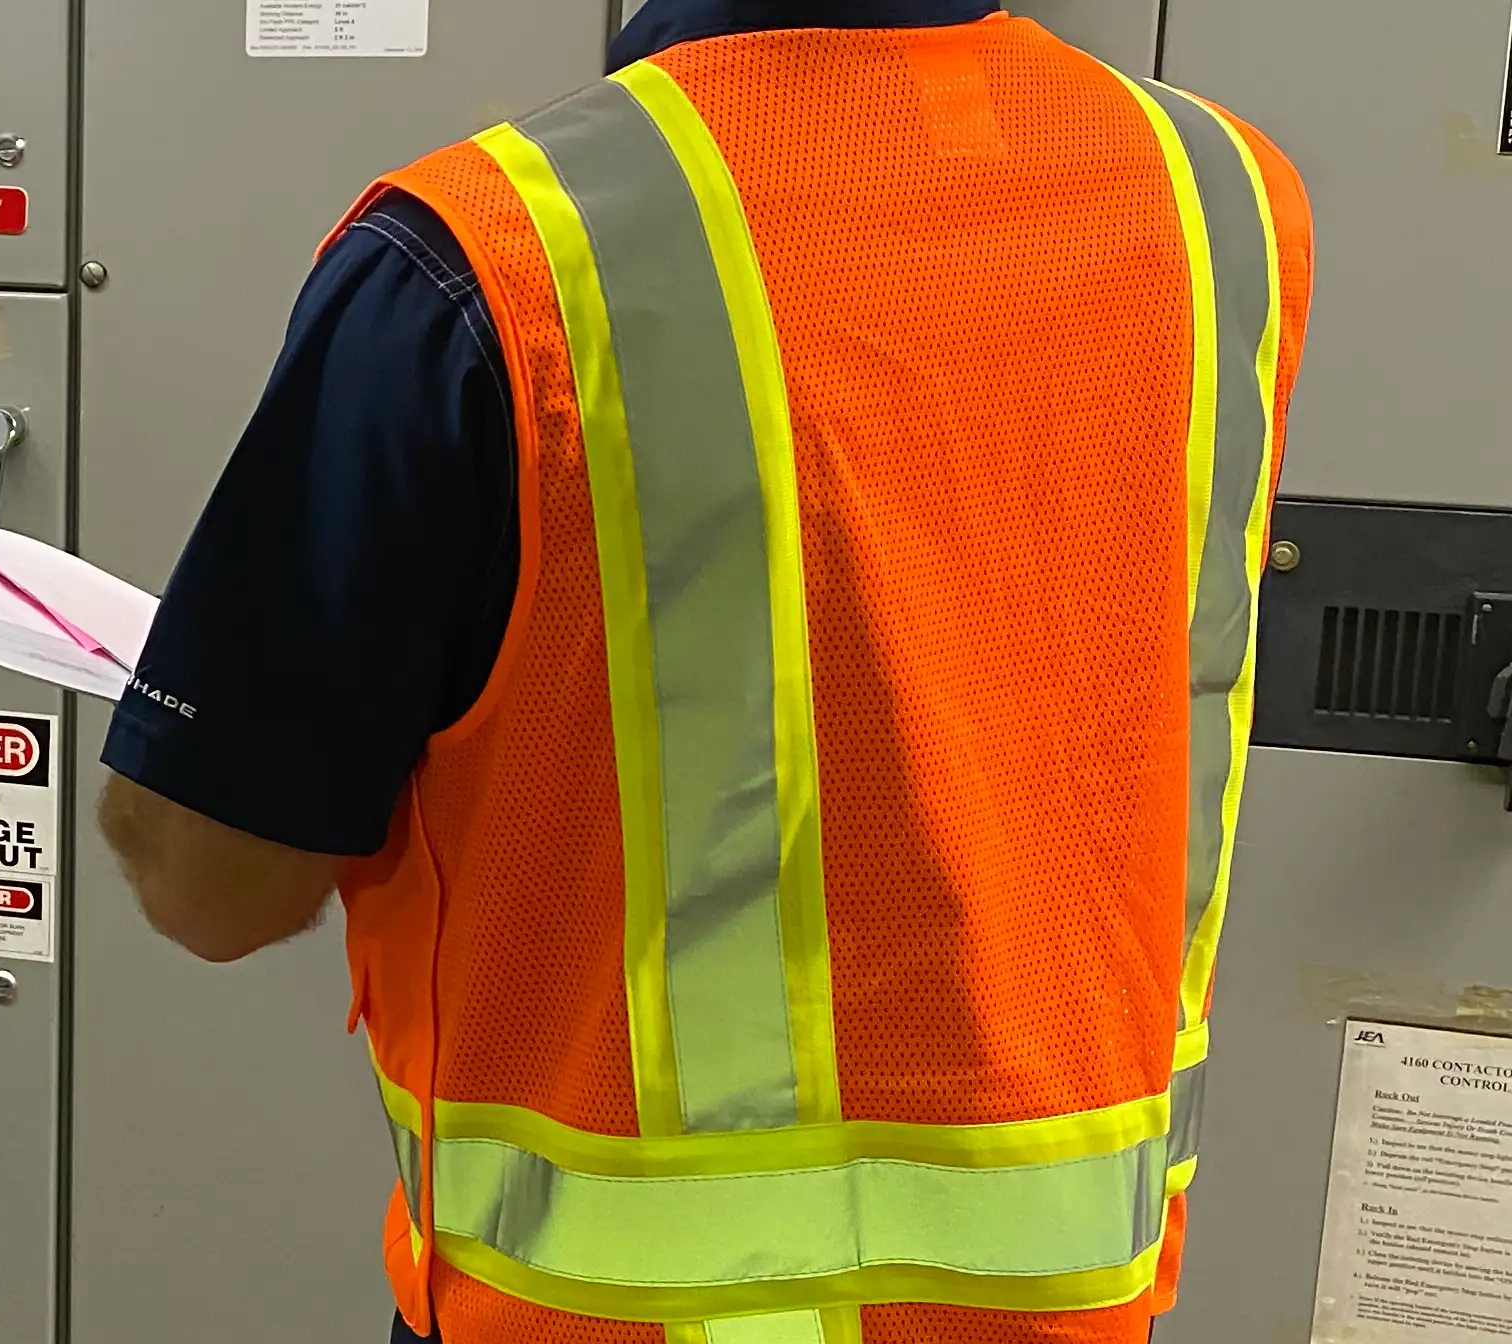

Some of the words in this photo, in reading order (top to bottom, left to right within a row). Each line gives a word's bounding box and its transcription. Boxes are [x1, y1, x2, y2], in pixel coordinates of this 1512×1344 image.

[1353, 1030, 1385, 1044] JEA
[1400, 1056, 1429, 1068] 4160
[1374, 1089, 1399, 1101] Rack
[1401, 1092, 1420, 1103] Out
